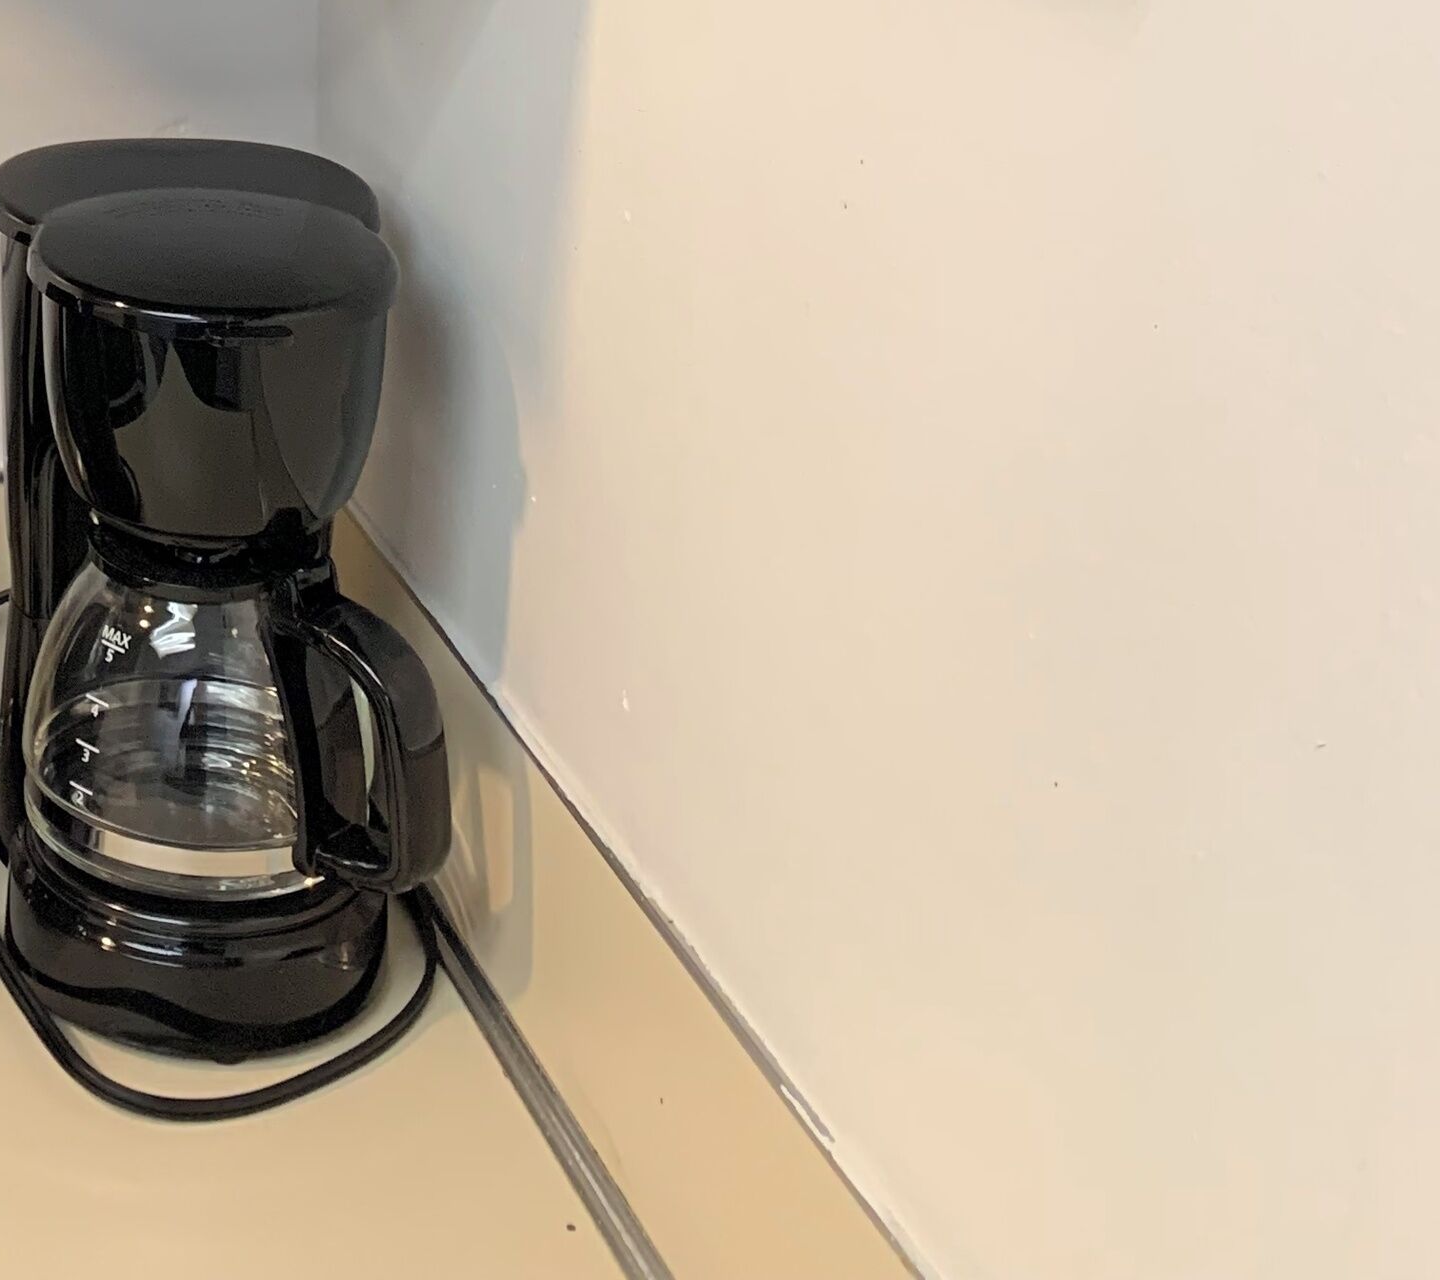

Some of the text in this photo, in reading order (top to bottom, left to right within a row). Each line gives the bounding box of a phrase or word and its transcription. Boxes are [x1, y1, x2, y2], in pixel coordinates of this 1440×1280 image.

[101, 624, 132, 649] MAX
[105, 649, 114, 663] 5
[81, 749, 90, 763] 3
